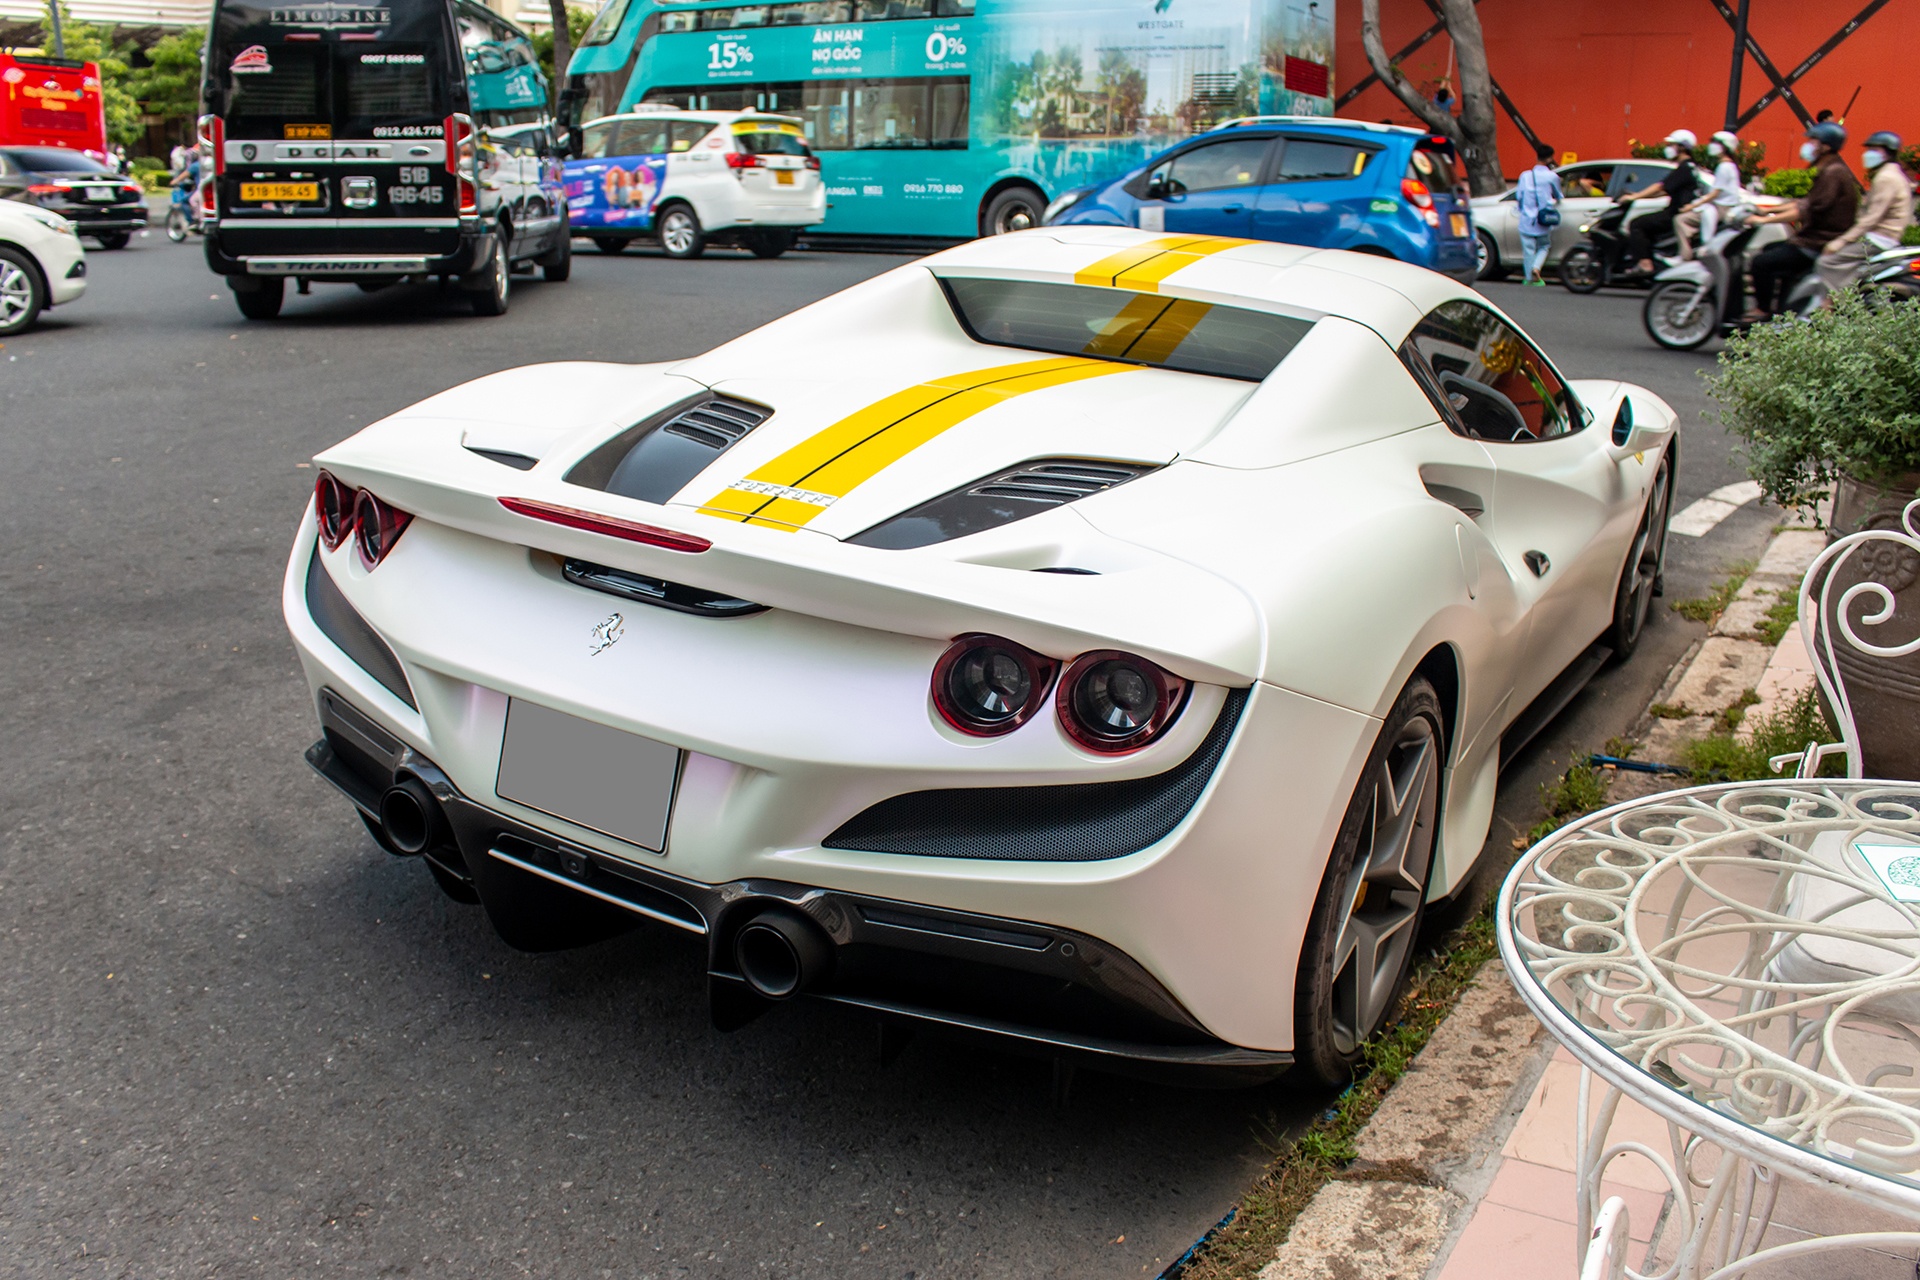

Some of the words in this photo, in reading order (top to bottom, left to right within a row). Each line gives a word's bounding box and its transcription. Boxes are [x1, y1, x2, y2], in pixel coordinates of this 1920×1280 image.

[269, 10, 392, 22] LIMOUSINE
[1137, 20, 1184, 29] WESTGATE
[925, 32, 967, 62] 0%
[707, 42, 754, 70] 15%
[399, 167, 430, 184] 51B
[927, 184, 944, 194] 770
[1370, 200, 1398, 213] Grab
[285, 262, 385, 271] TRANSIT
[728, 479, 839, 508] Ferrari
